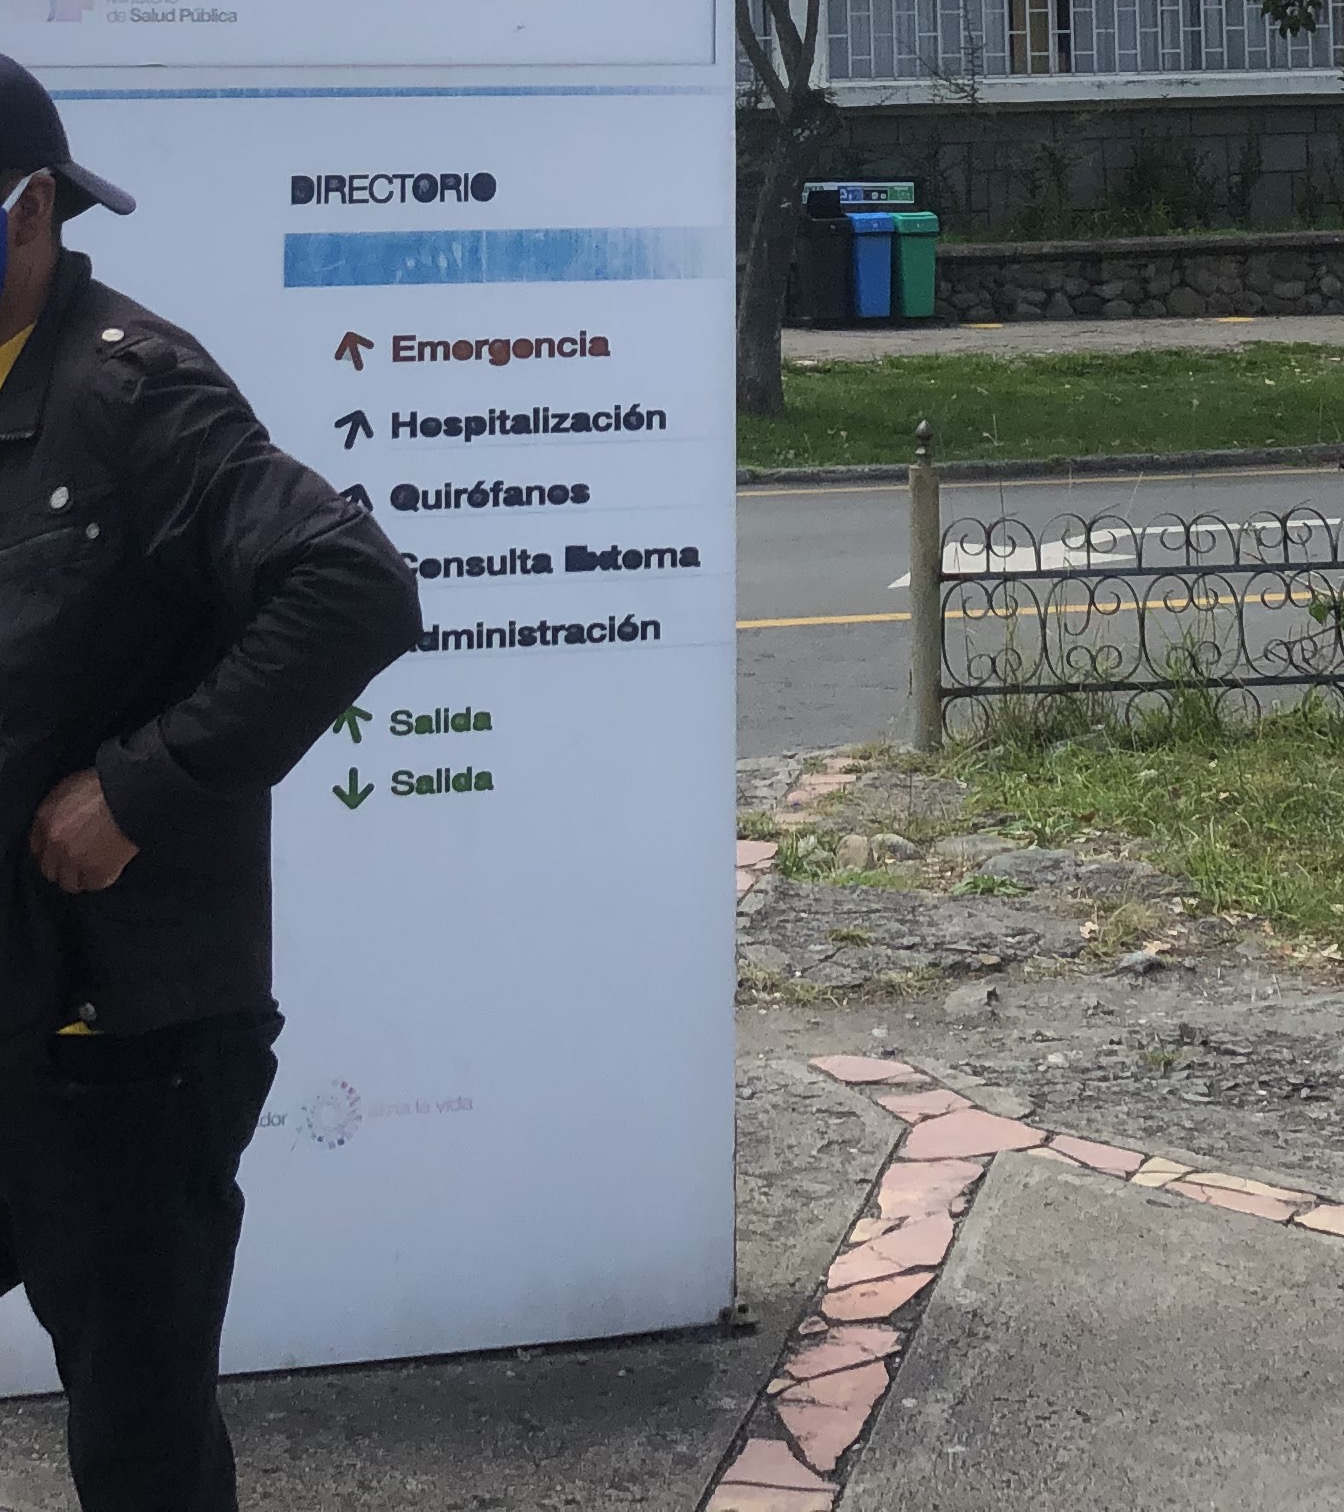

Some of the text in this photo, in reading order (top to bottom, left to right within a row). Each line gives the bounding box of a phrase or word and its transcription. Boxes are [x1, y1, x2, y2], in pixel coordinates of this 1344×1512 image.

[130, 8, 176, 23] Salud
[179, 7, 238, 23] Pública
[291, 172, 497, 205] DIRECTORIO
[392, 330, 610, 366] Emergencia
[391, 403, 667, 442] Hospitalización
[390, 480, 591, 513] Quirófanos
[411, 614, 661, 652] dministración
[390, 706, 493, 737] Salida
[391, 766, 495, 797] Salida
